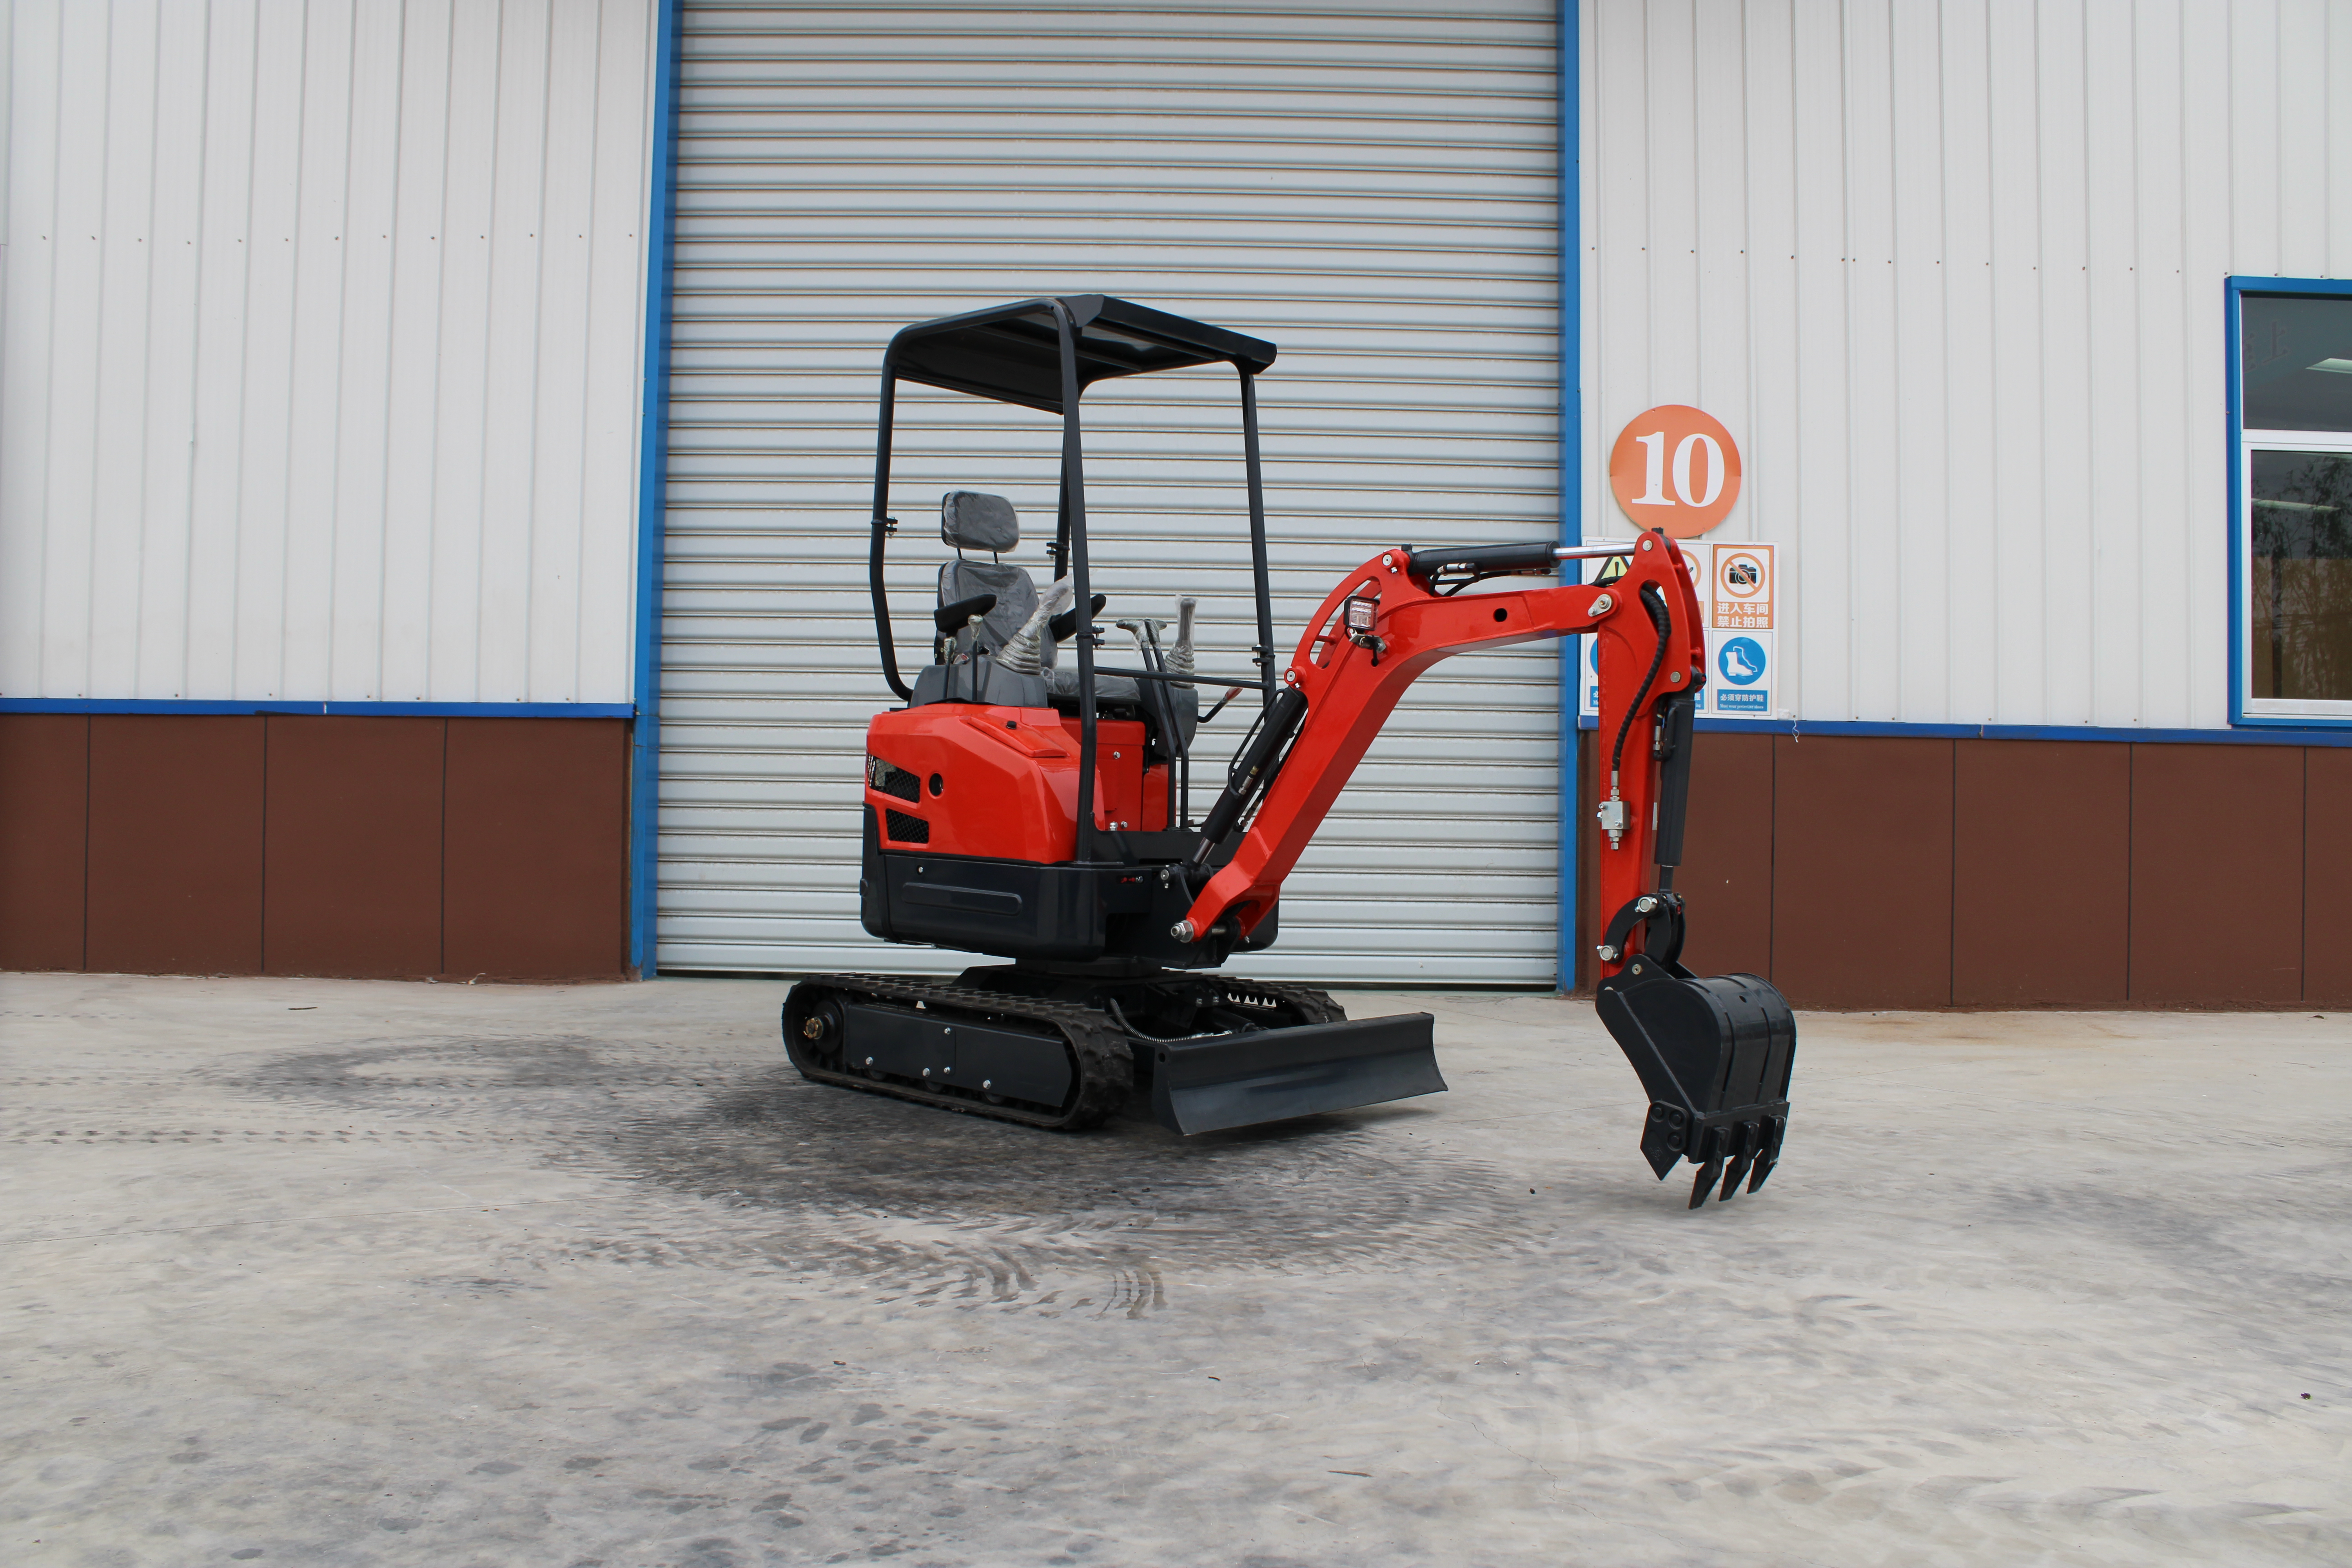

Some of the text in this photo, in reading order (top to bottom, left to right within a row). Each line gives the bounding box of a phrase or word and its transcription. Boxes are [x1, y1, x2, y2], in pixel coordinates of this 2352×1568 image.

[1632, 431, 1725, 508] 10
[1717, 603, 1769, 615] 进入车间
[1717, 616, 1769, 628] 禁止拍照
[1720, 693, 1764, 702] 必须穿防护鞋
